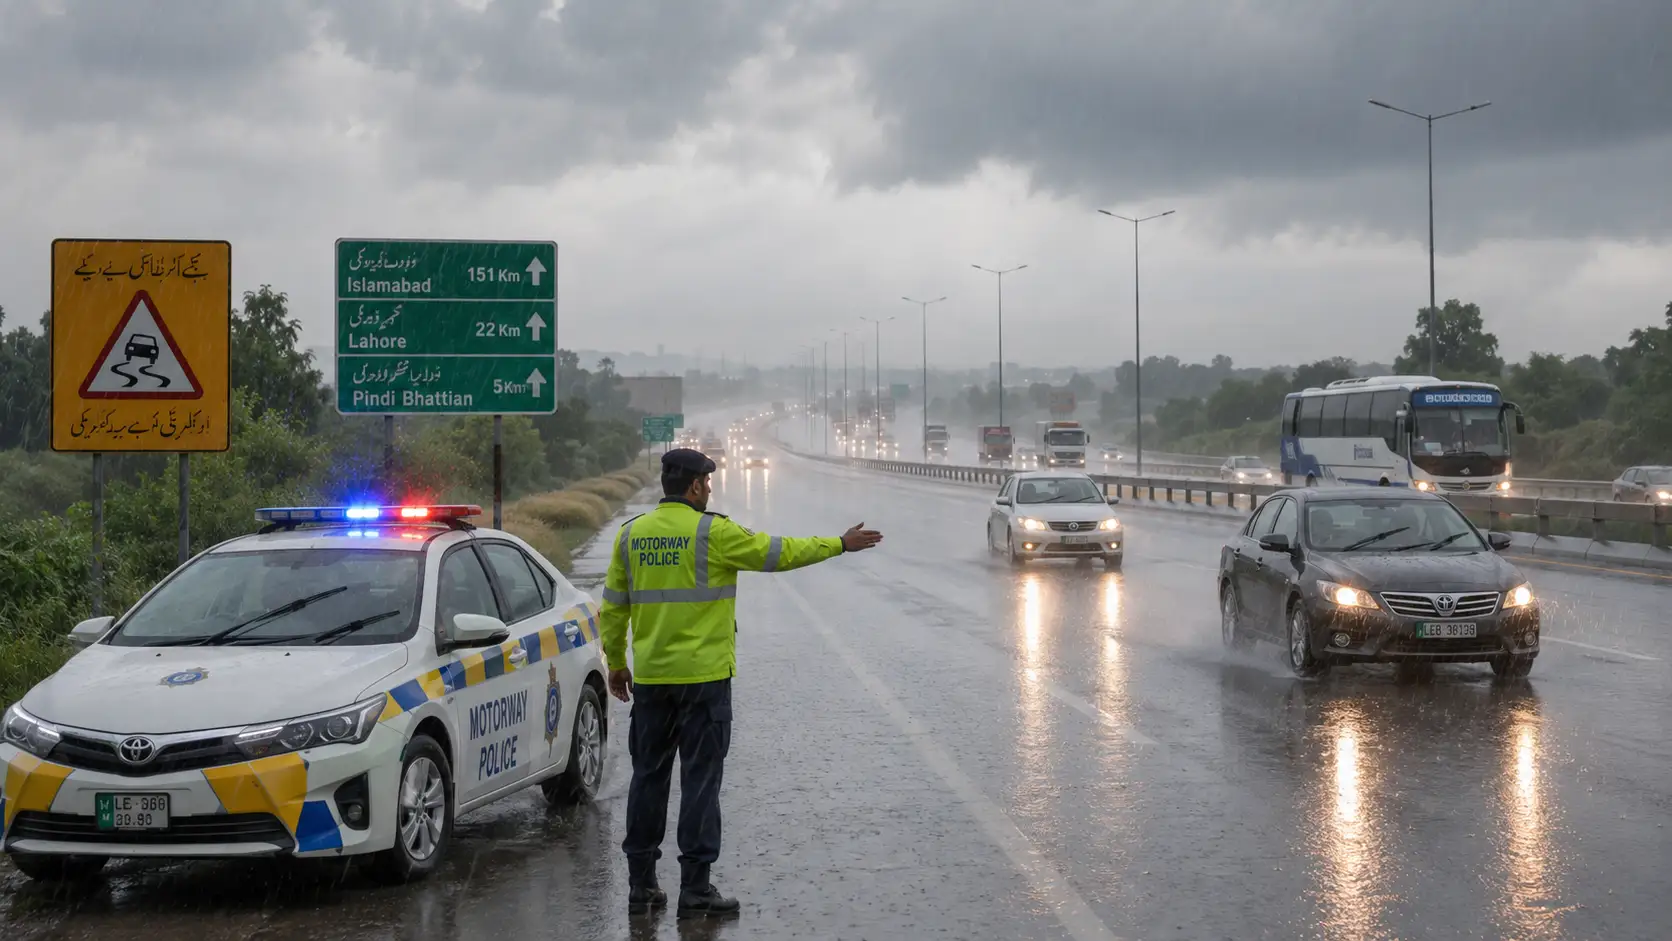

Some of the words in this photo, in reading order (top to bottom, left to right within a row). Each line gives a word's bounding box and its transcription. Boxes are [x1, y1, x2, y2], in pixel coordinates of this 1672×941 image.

[467, 266, 494, 282] 151
[498, 268, 521, 282] Km
[347, 276, 431, 293] Islamabad
[475, 321, 496, 337] 22
[498, 323, 521, 337] Km
[348, 332, 407, 349] Lahore
[492, 379, 503, 394] 5
[353, 390, 396, 407] Pindi
[402, 390, 473, 407] Bhattian
[631, 536, 691, 550] MOTORWAY
[639, 552, 680, 567] POLICE
[469, 689, 528, 741] MOTORWAY
[478, 735, 518, 781] POLICE
